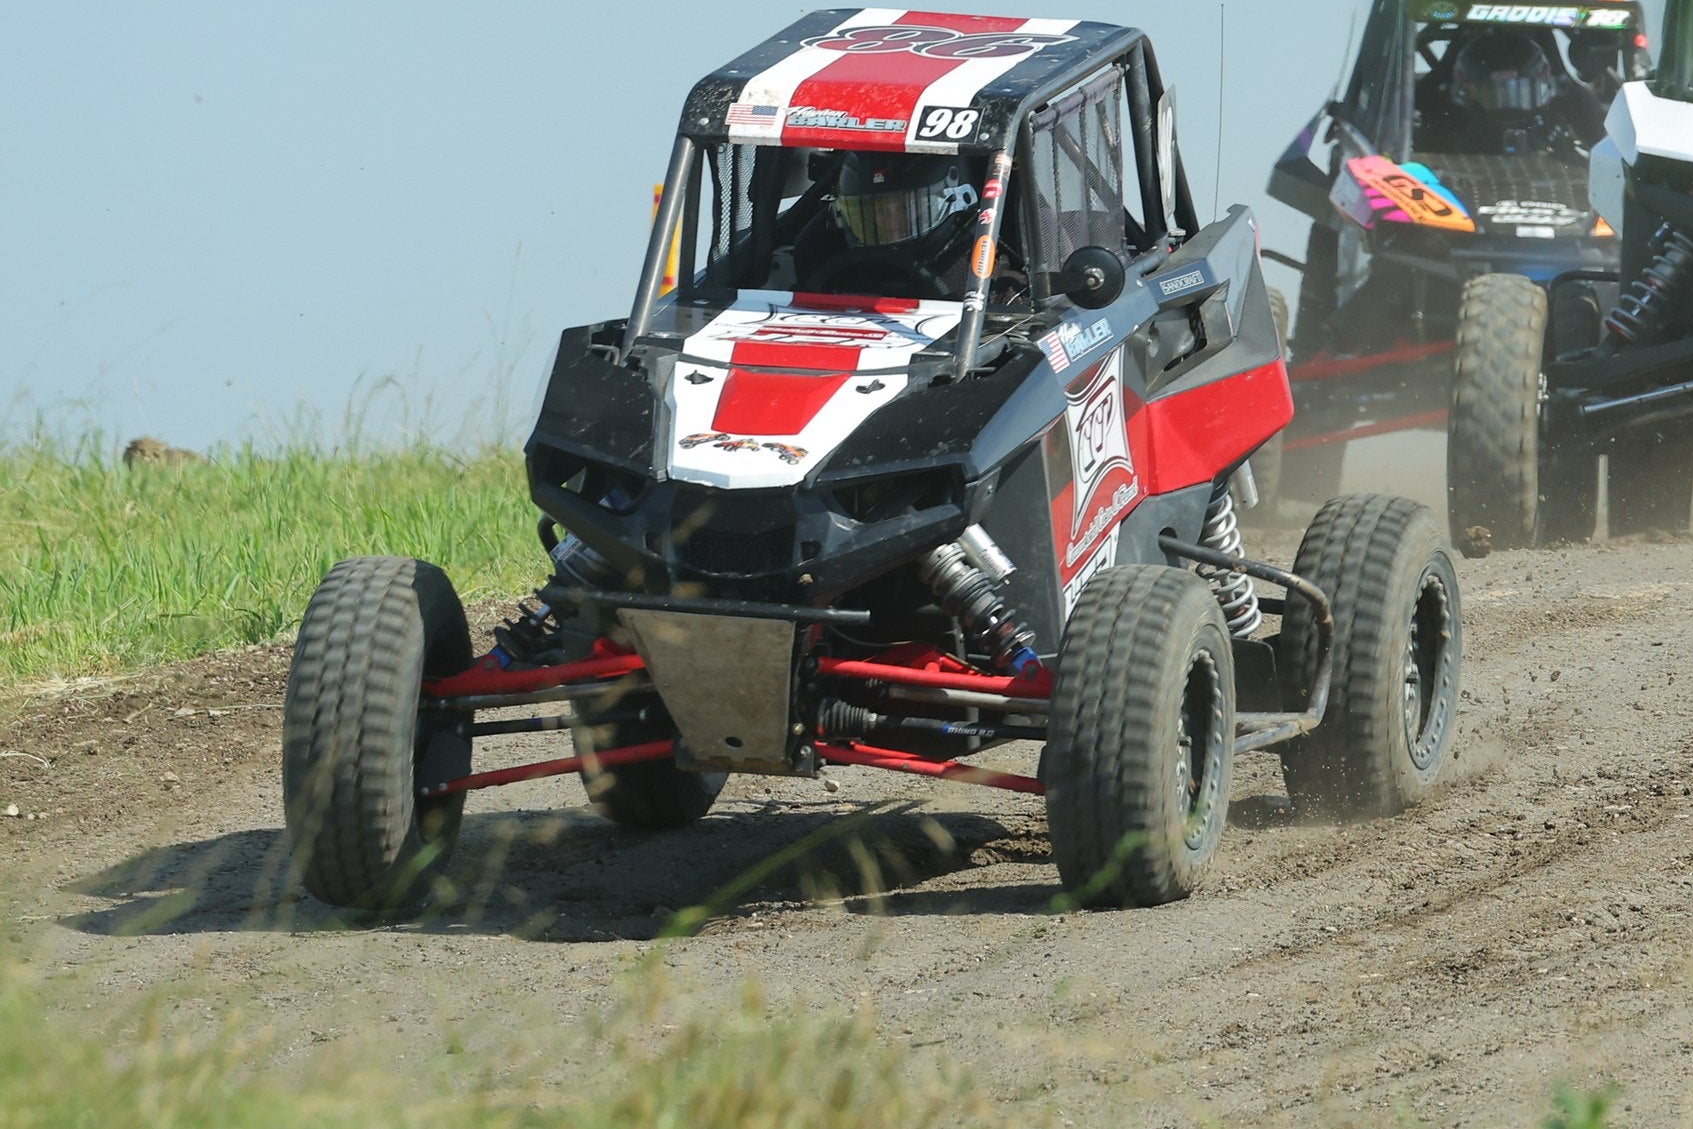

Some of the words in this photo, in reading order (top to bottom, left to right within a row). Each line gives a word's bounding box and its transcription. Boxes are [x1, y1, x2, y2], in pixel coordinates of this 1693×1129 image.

[786, 114, 907, 132] BARLER
[919, 108, 974, 140] 98
[1161, 272, 1204, 294] SANDCRAFT
